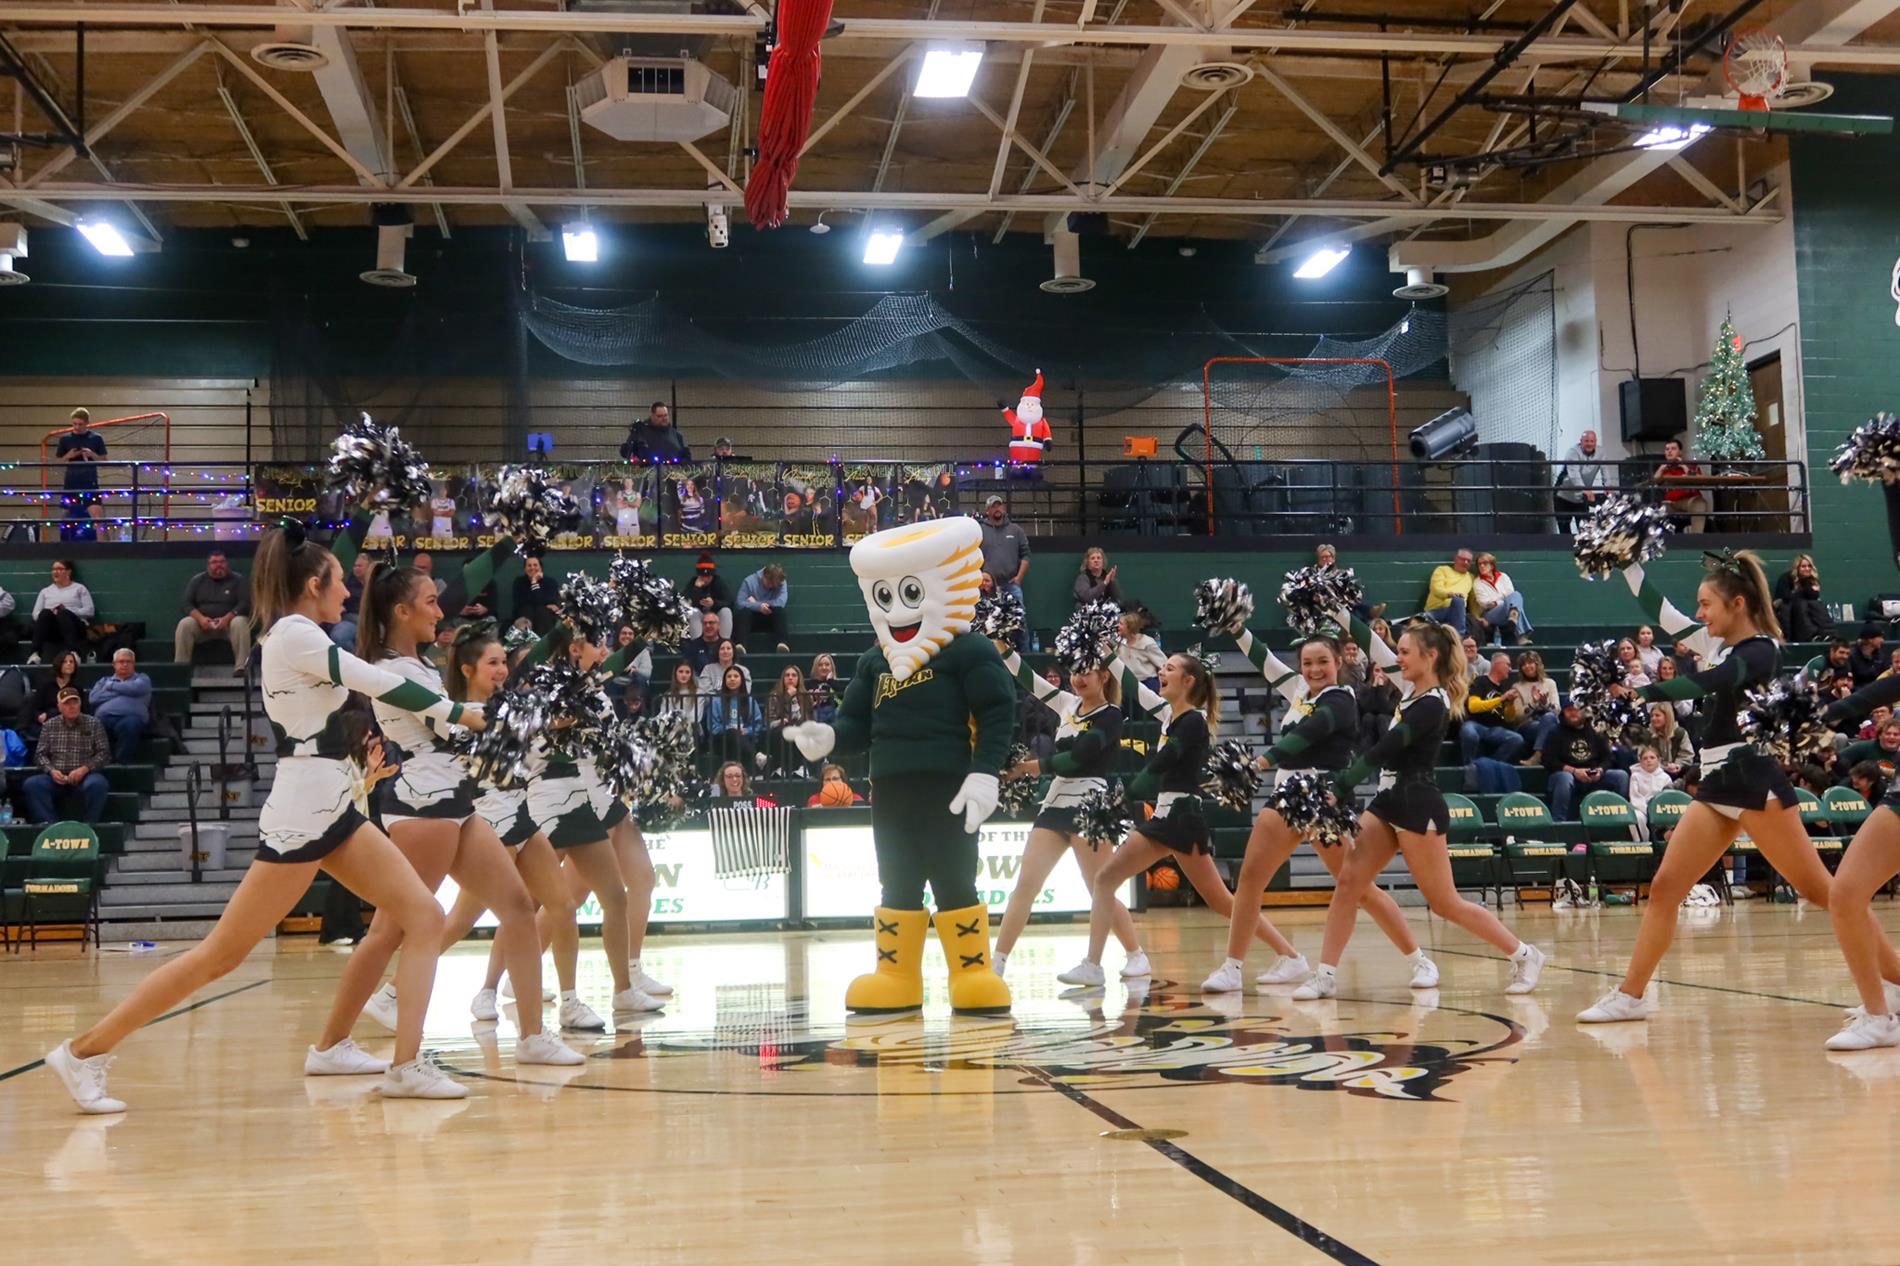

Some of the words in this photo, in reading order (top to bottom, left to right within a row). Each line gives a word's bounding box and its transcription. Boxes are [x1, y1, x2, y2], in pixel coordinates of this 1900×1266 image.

[256, 498, 316, 512] SENIOR
[415, 536, 469, 549] SENIOR
[603, 535, 656, 548] SENIOR
[663, 532, 717, 547] SENIOR
[723, 534, 776, 547] SENIOR
[783, 534, 835, 547] SENIOR
[1504, 807, 1544, 817] A-TOWN
[1588, 804, 1628, 816] A-TOWN
[1830, 801, 1866, 811] A-TOWN
[41, 838, 90, 850] A-TOWN
